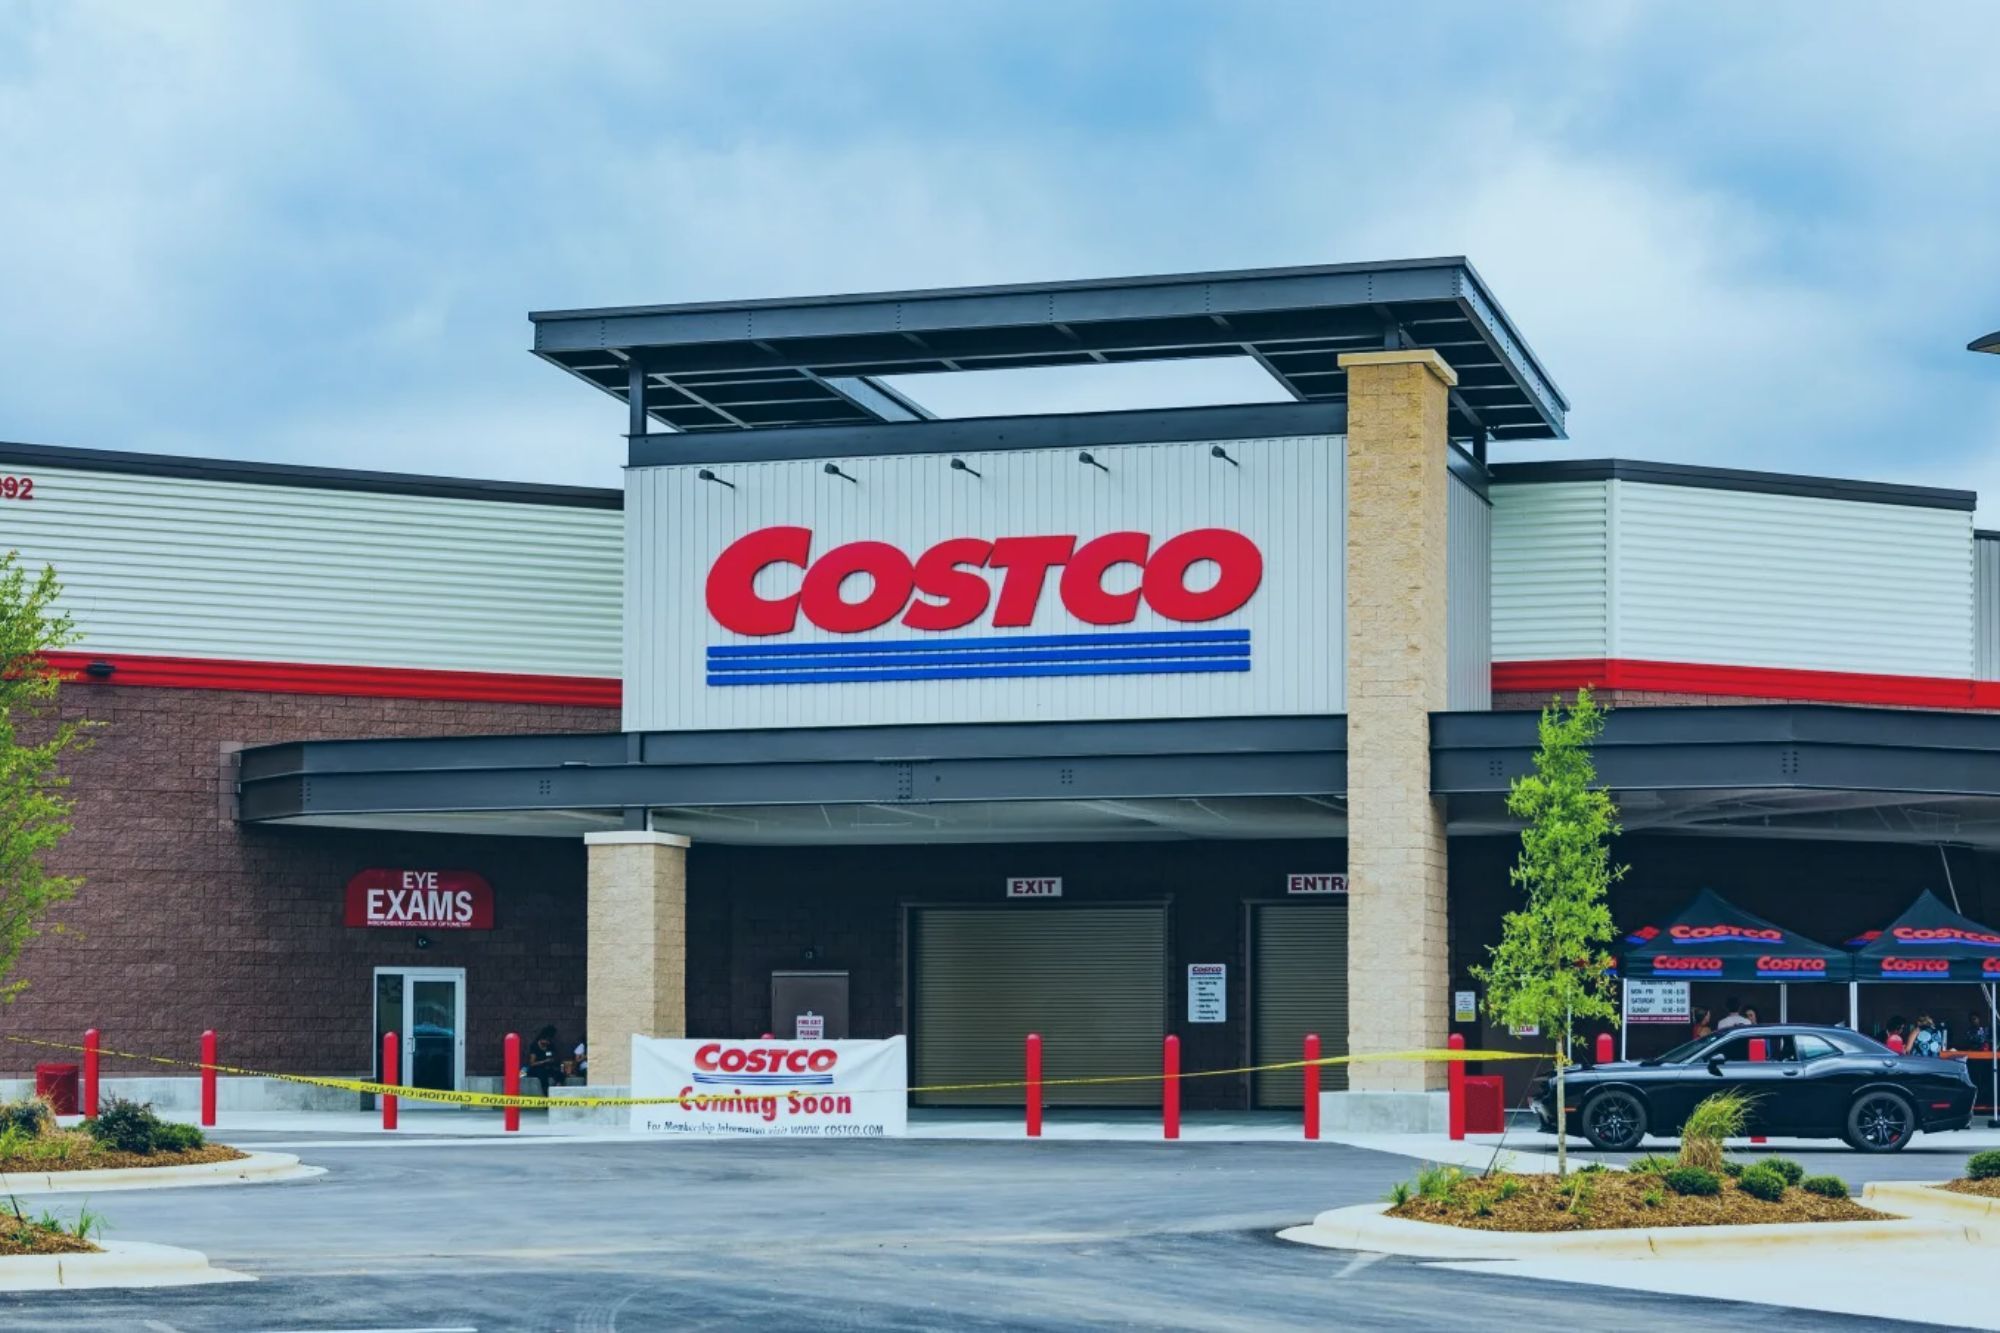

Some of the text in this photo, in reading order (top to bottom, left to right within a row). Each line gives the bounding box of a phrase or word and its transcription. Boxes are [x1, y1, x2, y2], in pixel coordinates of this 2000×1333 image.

[0, 476, 33, 500] 92
[706, 526, 1263, 636] COSTCO
[403, 871, 438, 889] EYE
[1012, 879, 1056, 894] EXIT
[367, 888, 473, 922] EXAMS
[1669, 924, 1783, 940] COSTCO
[1652, 955, 1723, 970] COSTCO
[1756, 955, 1827, 970] COSTCO
[1881, 956, 1949, 971] COSTCO
[694, 1043, 838, 1073] COSTCO
[679, 1086, 852, 1121] Coming Soon
